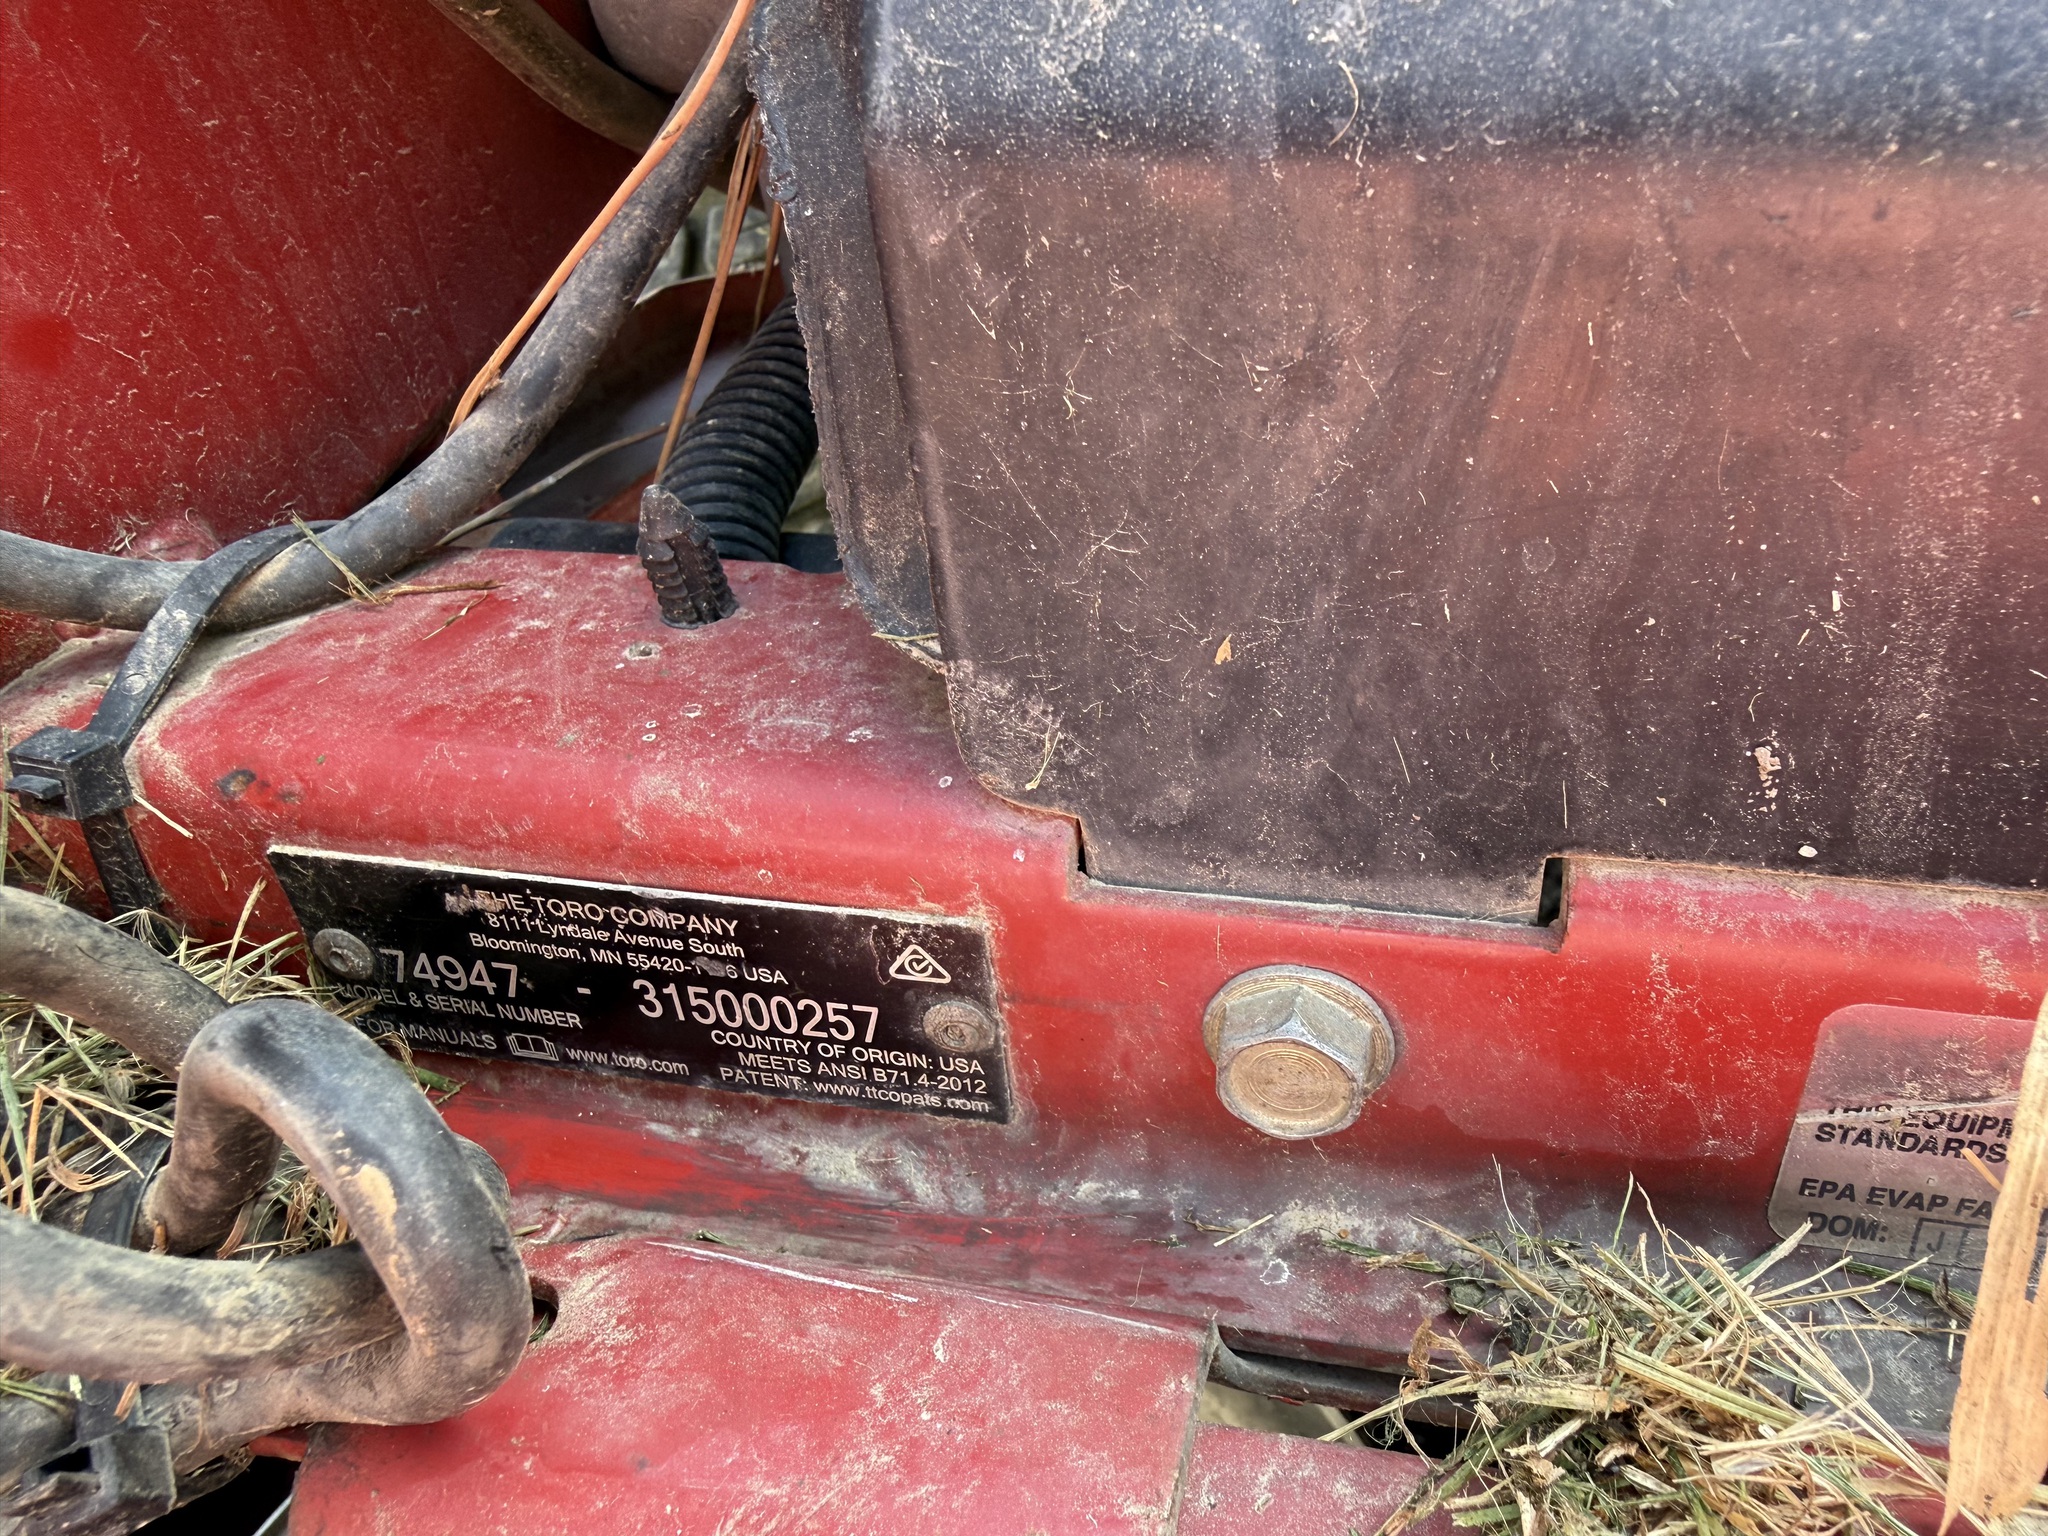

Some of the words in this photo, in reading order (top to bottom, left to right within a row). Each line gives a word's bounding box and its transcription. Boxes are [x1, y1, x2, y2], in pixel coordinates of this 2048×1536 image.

[530, 896, 604, 922] TORO
[610, 906, 738, 937] COMPANY
[469, 932, 587, 962] Bloomington,
[589, 947, 623, 965] MN
[626, 952, 738, 979] 55420-16
[741, 962, 789, 985] USA
[614, 929, 684, 951] Avenue
[688, 938, 745, 958] South
[337, 983, 407, 1006] MODEL
[408, 991, 424, 1009] &
[427, 994, 496, 1018] SERIAL
[497, 1003, 583, 1029] NUMBER
[380, 948, 518, 998] 74947
[632, 978, 879, 1043] 315000257
[400, 1023, 498, 1050] MANUALS
[710, 1030, 812, 1055] COUNTRY
[817, 1043, 846, 1058] OF
[852, 1048, 934, 1069] ORIGIN:
[939, 1056, 986, 1075] USA
[565, 1047, 690, 1076] www.toro.com
[738, 1052, 812, 1074] MEETS
[817, 1062, 868, 1081] ANSI
[873, 1068, 988, 1094] B71.4-2012
[719, 1067, 809, 1091] PATENT:
[813, 1081, 990, 1113] www.ttcopats.com
[1798, 1177, 1856, 1202] EPA
[1865, 1186, 1949, 1212] EVAP
[1807, 1211, 1889, 1243] DOM:
